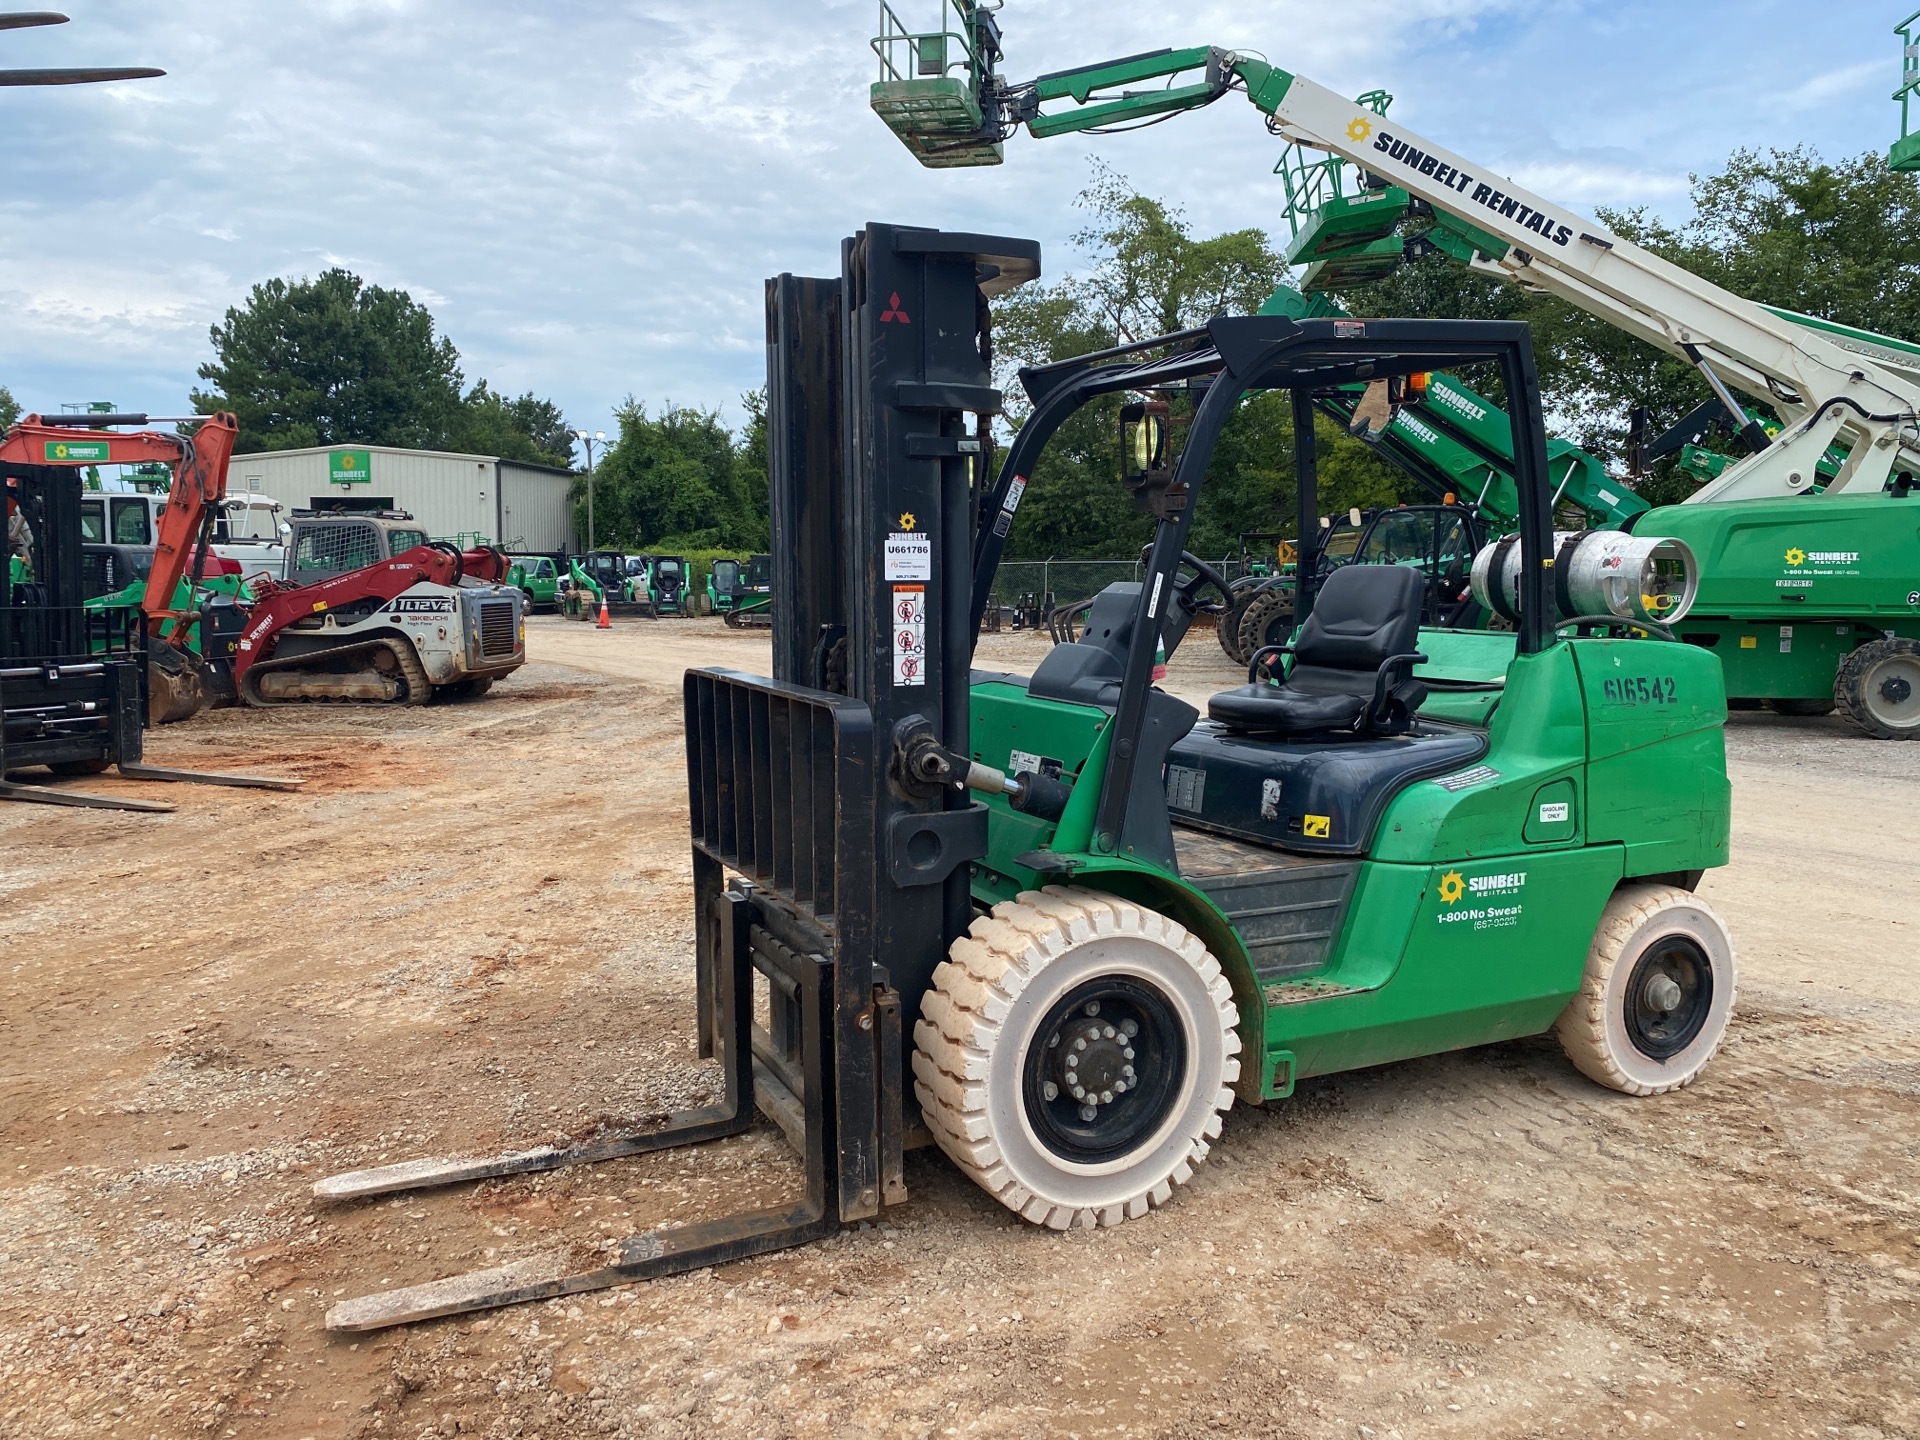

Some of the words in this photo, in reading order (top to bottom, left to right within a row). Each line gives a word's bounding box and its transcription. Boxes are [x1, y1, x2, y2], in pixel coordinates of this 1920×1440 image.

[1373, 131, 1473, 193] SUNBELT
[1471, 182, 1574, 247] RENTALS
[1431, 381, 1487, 420] SUNBELT
[1434, 395, 1473, 420] RENTALS
[1396, 419, 1427, 443] RENTALS
[332, 470, 366, 478] SUNBELT
[888, 532, 927, 540] SUNBELT
[888, 545, 928, 554] U661786
[1808, 552, 1860, 561] SUNBELT
[1603, 676, 1678, 705] 616542
[1468, 872, 1527, 891] SUNBELT
[1437, 910, 1468, 924] 1-800
[1469, 909, 1485, 919] No
[1487, 904, 1523, 918] Sweat
